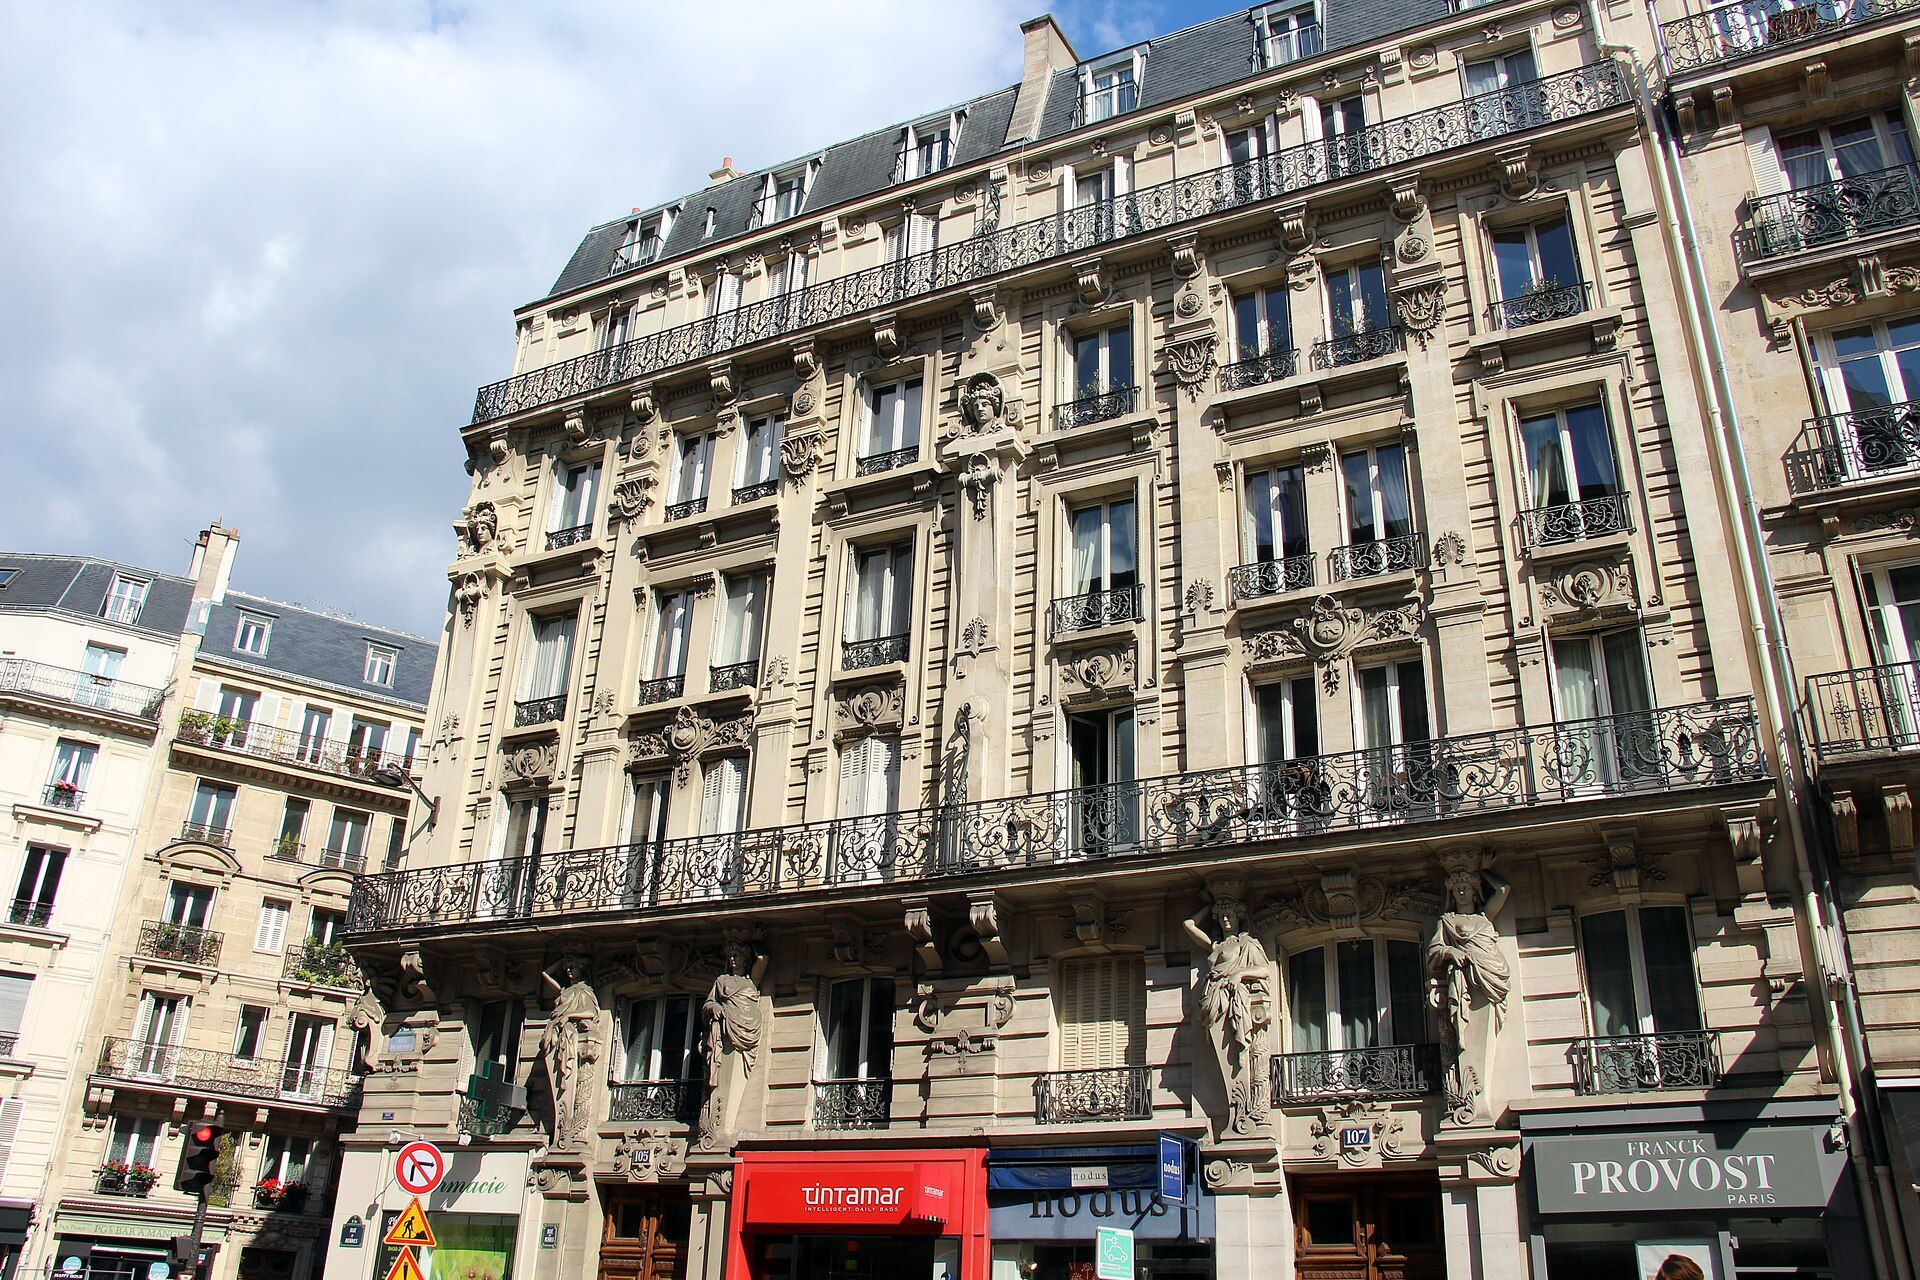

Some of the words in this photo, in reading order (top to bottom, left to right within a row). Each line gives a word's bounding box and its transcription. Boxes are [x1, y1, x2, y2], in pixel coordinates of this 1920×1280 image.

[1346, 1129, 1367, 1144] 107
[1627, 1138, 1706, 1156] FRANCK
[634, 1150, 649, 1162] 105
[1073, 1171, 1107, 1181] nodus
[1570, 1153, 1776, 1195] PROVOST
[440, 1176, 508, 1194] rmacie
[1029, 1188, 1169, 1218] nodus
[1727, 1193, 1776, 1205] PARIS
[115, 1226, 136, 1235] BAR
